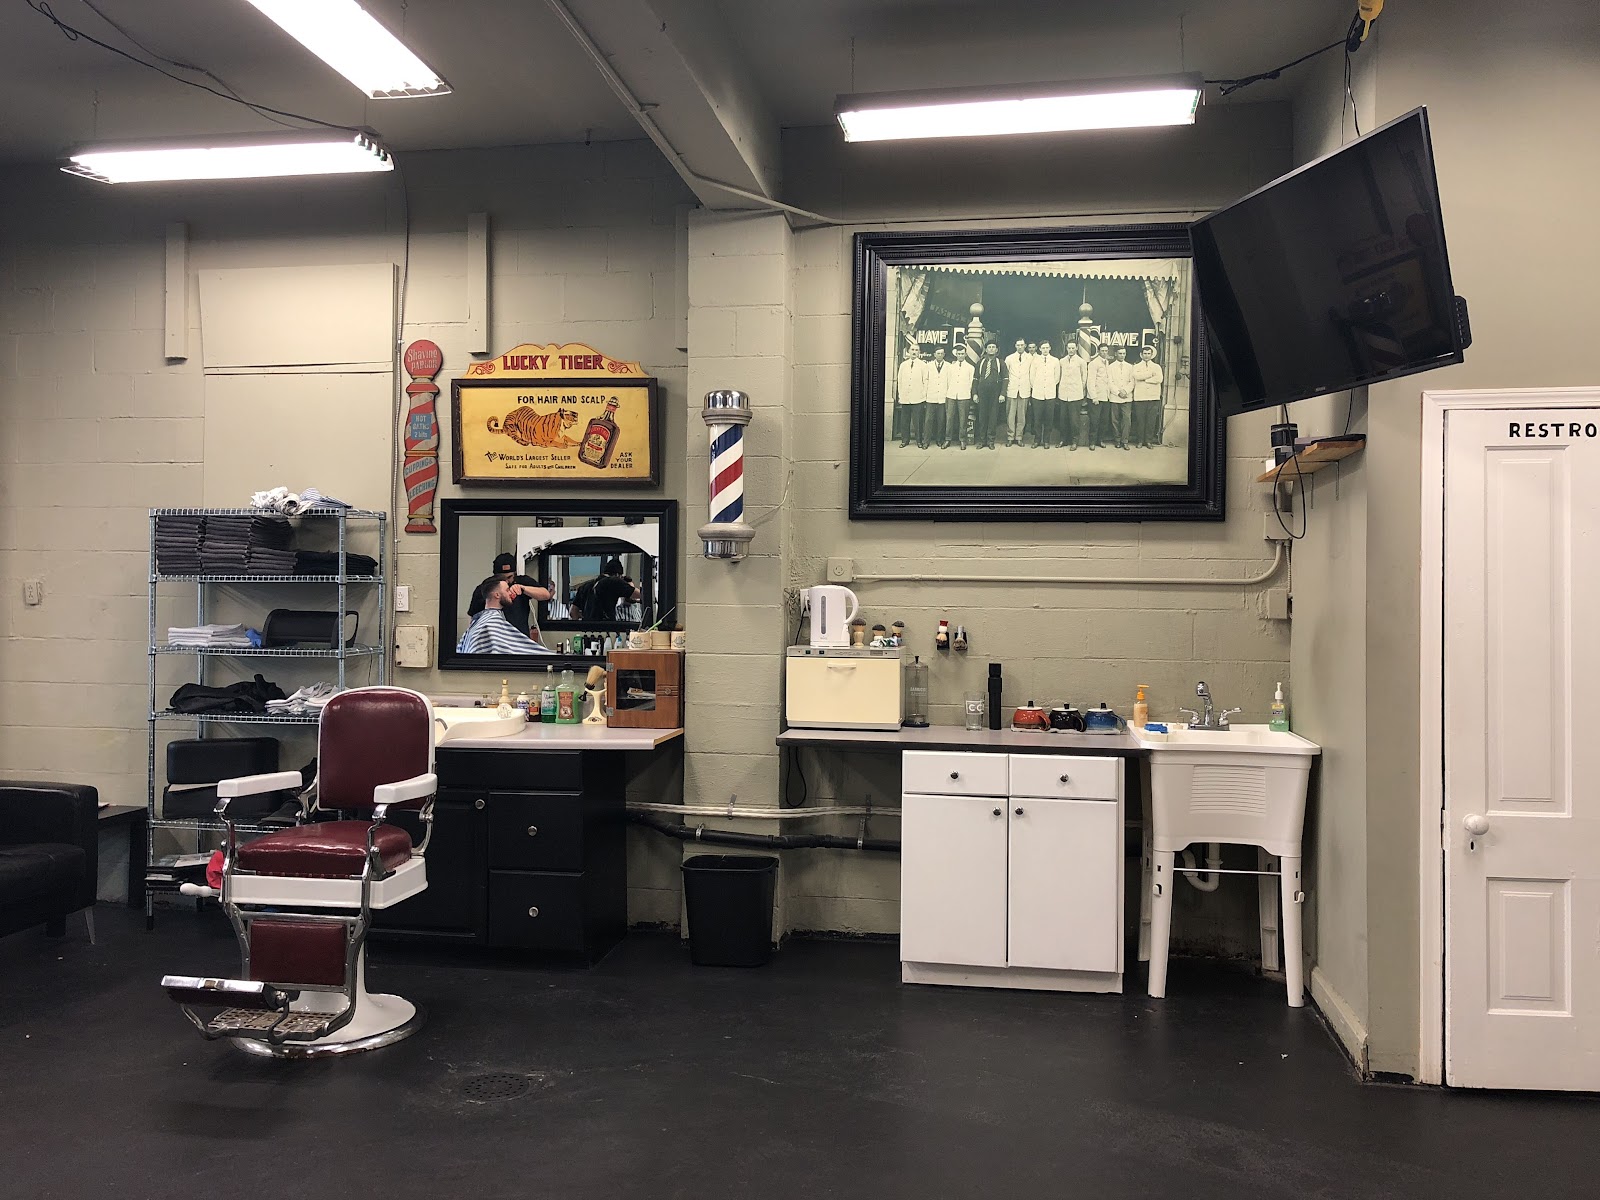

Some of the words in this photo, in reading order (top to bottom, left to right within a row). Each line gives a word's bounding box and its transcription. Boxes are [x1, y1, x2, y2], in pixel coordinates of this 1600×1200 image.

[407, 349, 438, 362] Shaving
[502, 354, 550, 371] LUCKY
[558, 354, 605, 370] TIGER
[517, 395, 535, 404] FOR
[537, 395, 558, 404] HAIR
[560, 395, 577, 404] AND
[415, 415, 427, 423] HOT
[525, 453, 549, 461] LARGEST
[550, 453, 571, 461] SELLER
